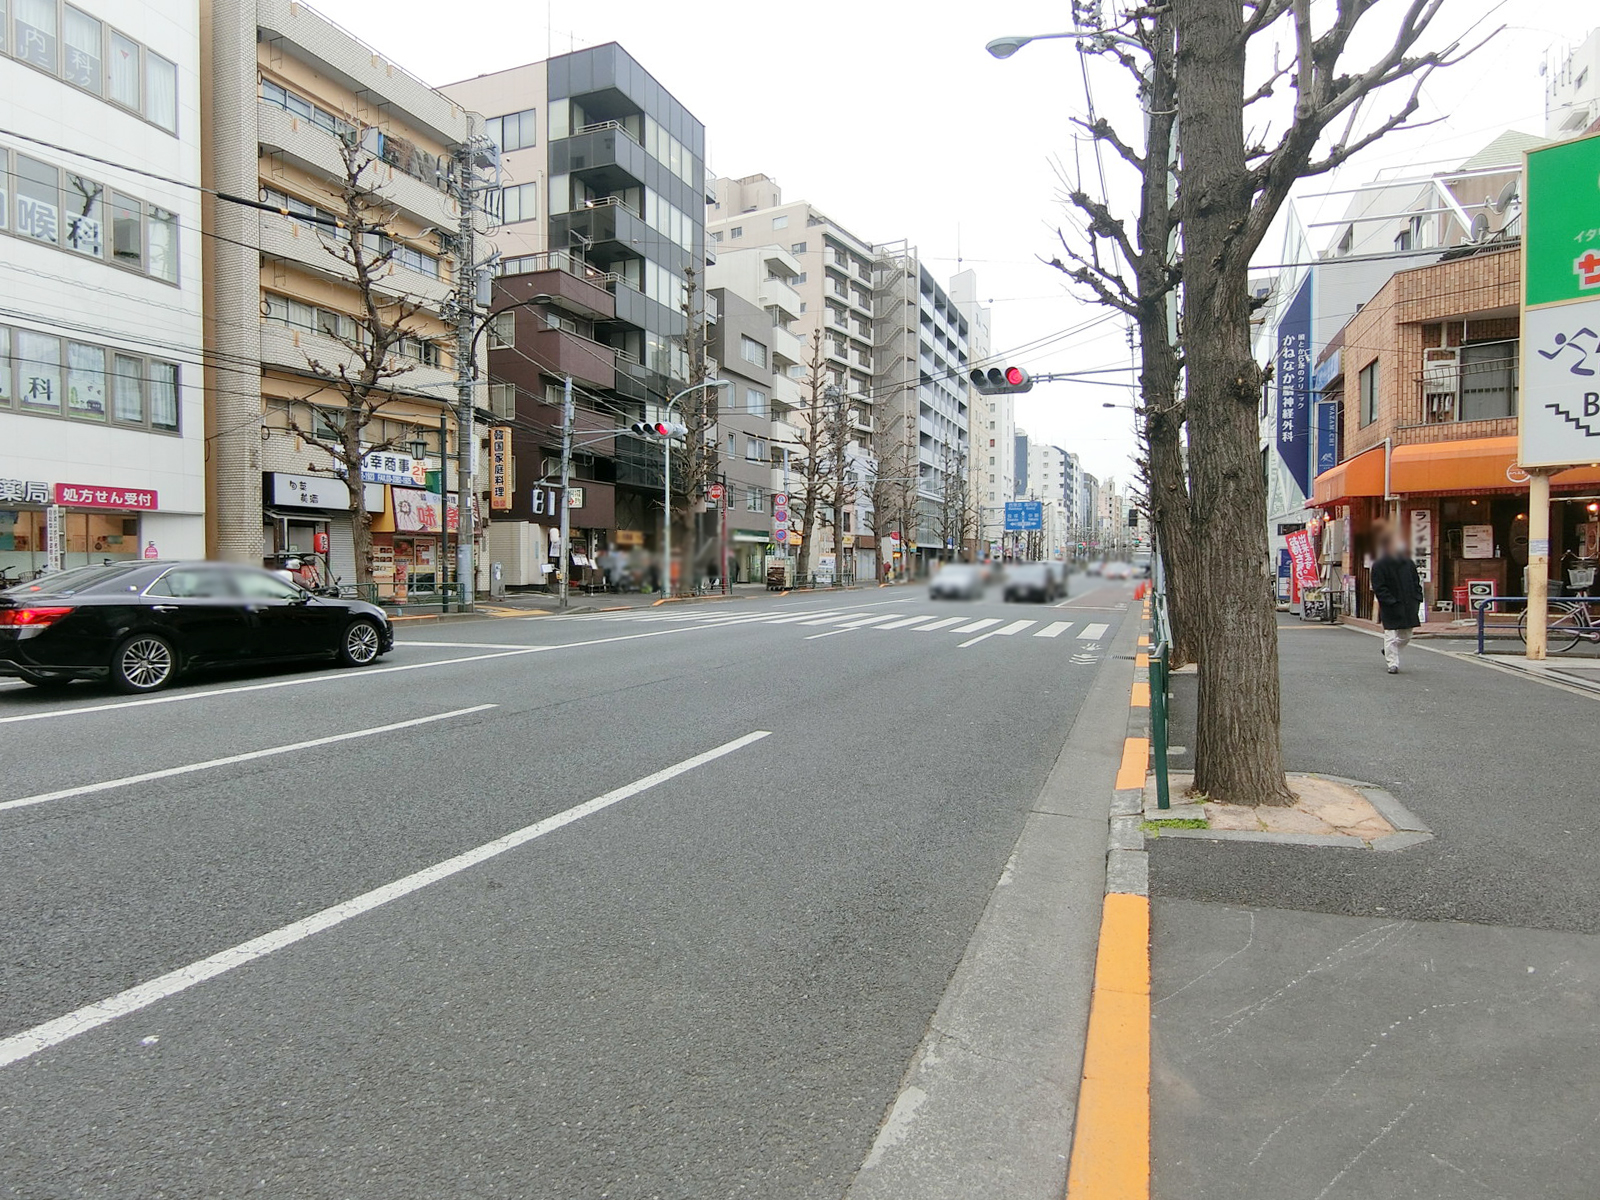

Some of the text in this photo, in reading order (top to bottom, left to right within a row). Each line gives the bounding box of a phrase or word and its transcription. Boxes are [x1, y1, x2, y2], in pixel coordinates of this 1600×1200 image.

[0, 36, 91, 86] リニック
[0, 192, 102, 255] 喉科
[1281, 334, 1296, 442] かねなか脳神経外科
[0, 479, 49, 503] 薬局
[494, 429, 504, 497] 韓国家庭料理
[63, 488, 152, 507] 処方せん受付
